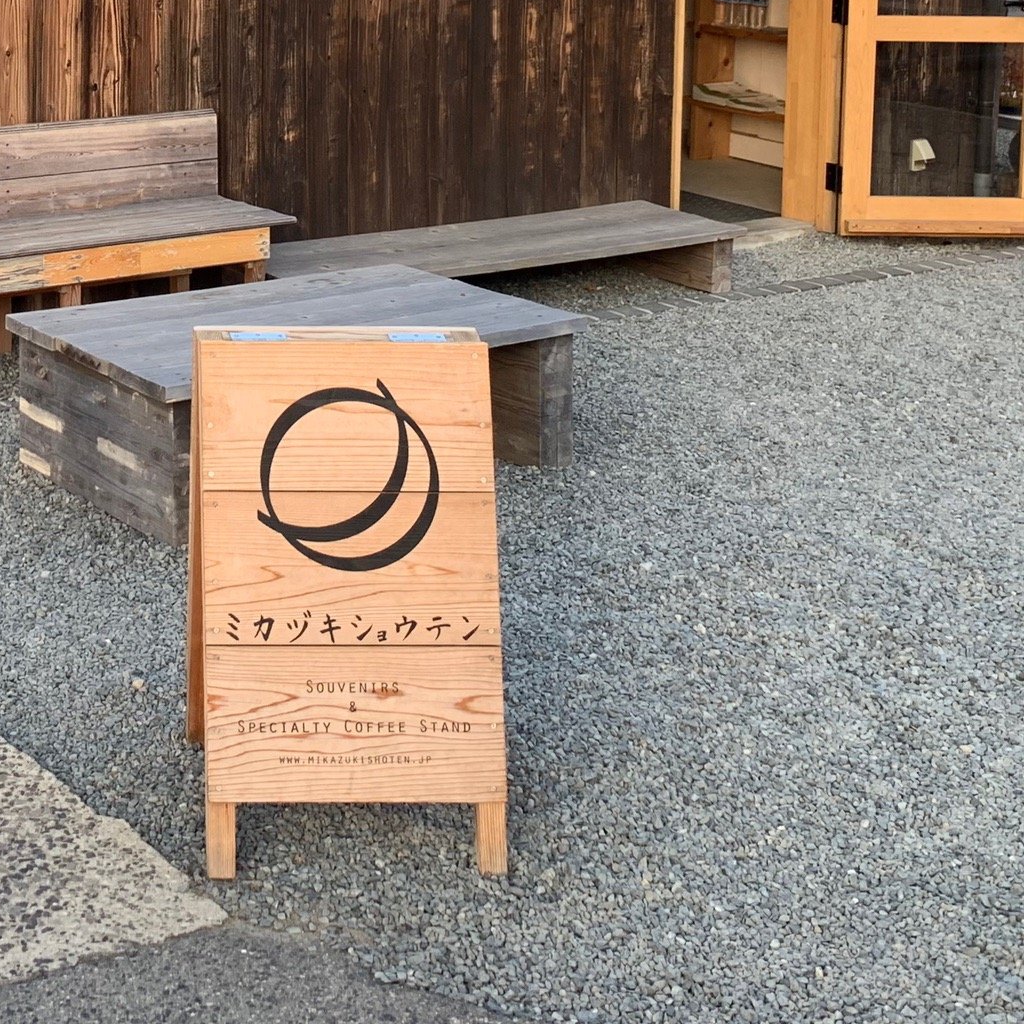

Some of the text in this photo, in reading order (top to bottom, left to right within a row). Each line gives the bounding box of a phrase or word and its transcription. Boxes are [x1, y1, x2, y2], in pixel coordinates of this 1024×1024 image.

[225, 609, 481, 644] ミカヅキショウテン
[305, 679, 400, 694] SOUVENIRS
[348, 700, 357, 713] &
[237, 719, 472, 734] SPECIALTY COFFEE STAND
[278, 755, 433, 765] WWW.MIKAZUKISHOTEN.JP
